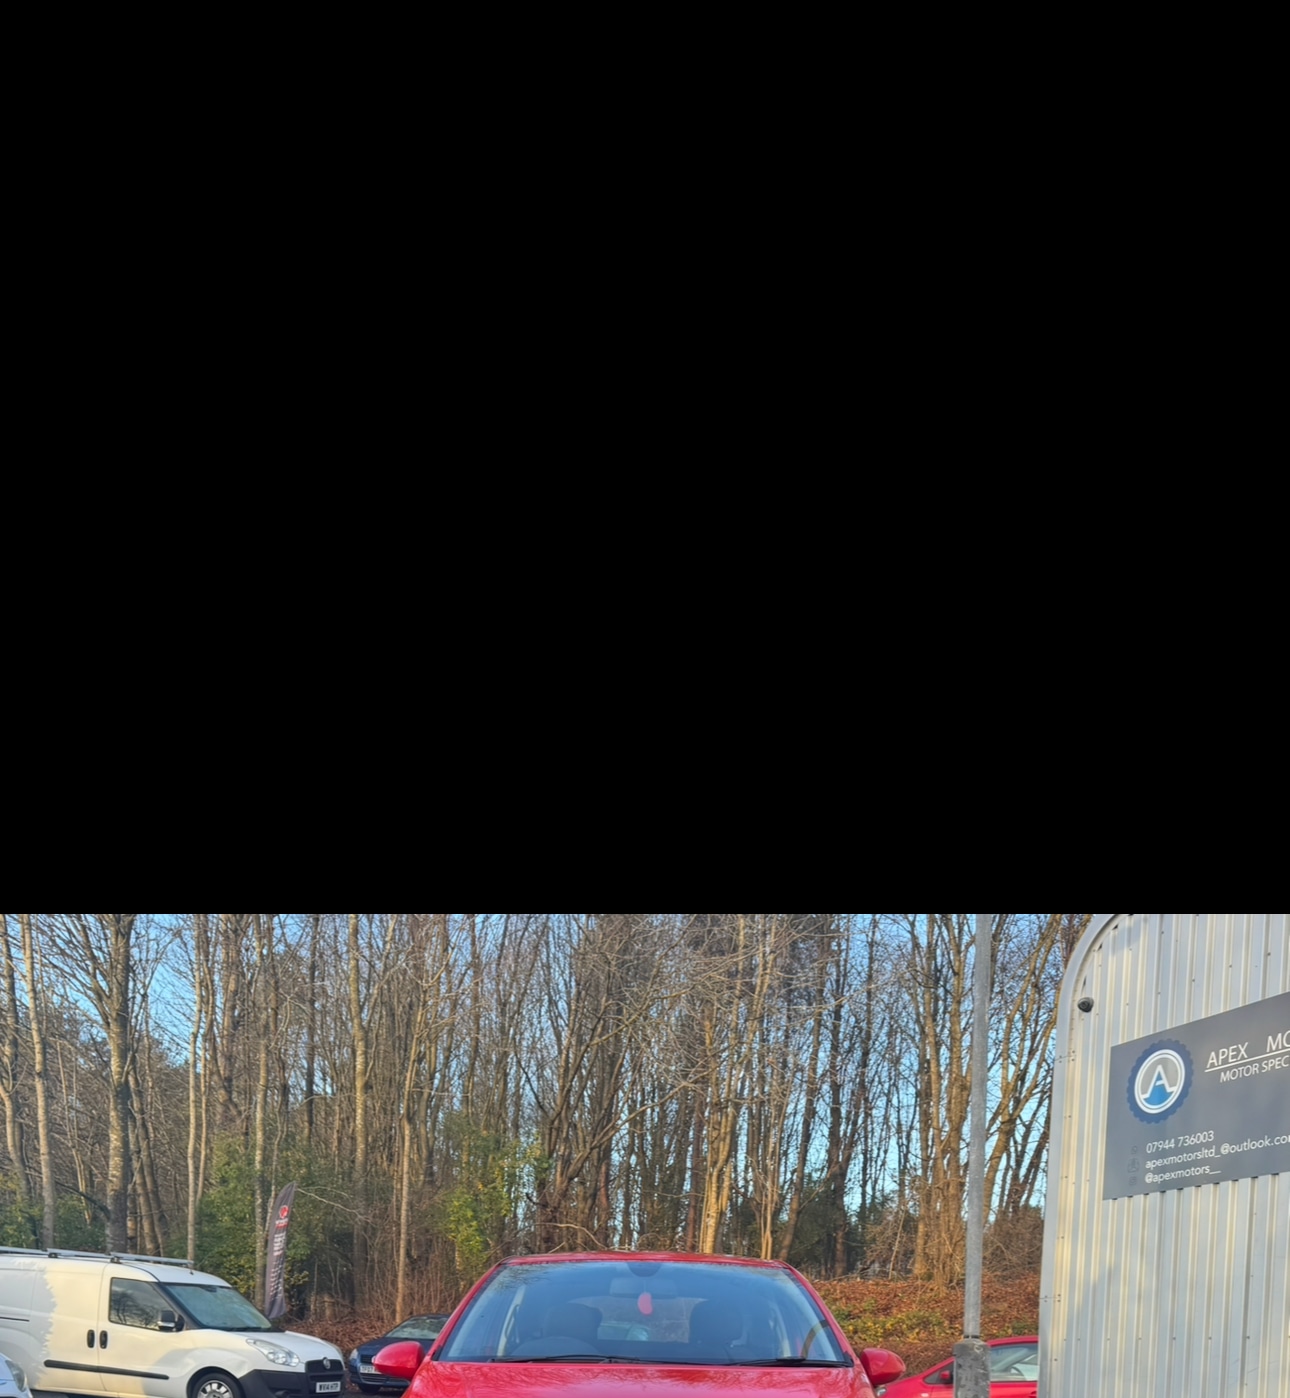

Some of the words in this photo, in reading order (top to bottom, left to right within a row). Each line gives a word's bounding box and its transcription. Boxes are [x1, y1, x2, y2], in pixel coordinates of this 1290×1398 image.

[1206, 1042, 1248, 1069] APEX
[1220, 1063, 1259, 1083] MOTOR
[1146, 1138, 1175, 1154] 07944
[1177, 1130, 1215, 1148] 736003
